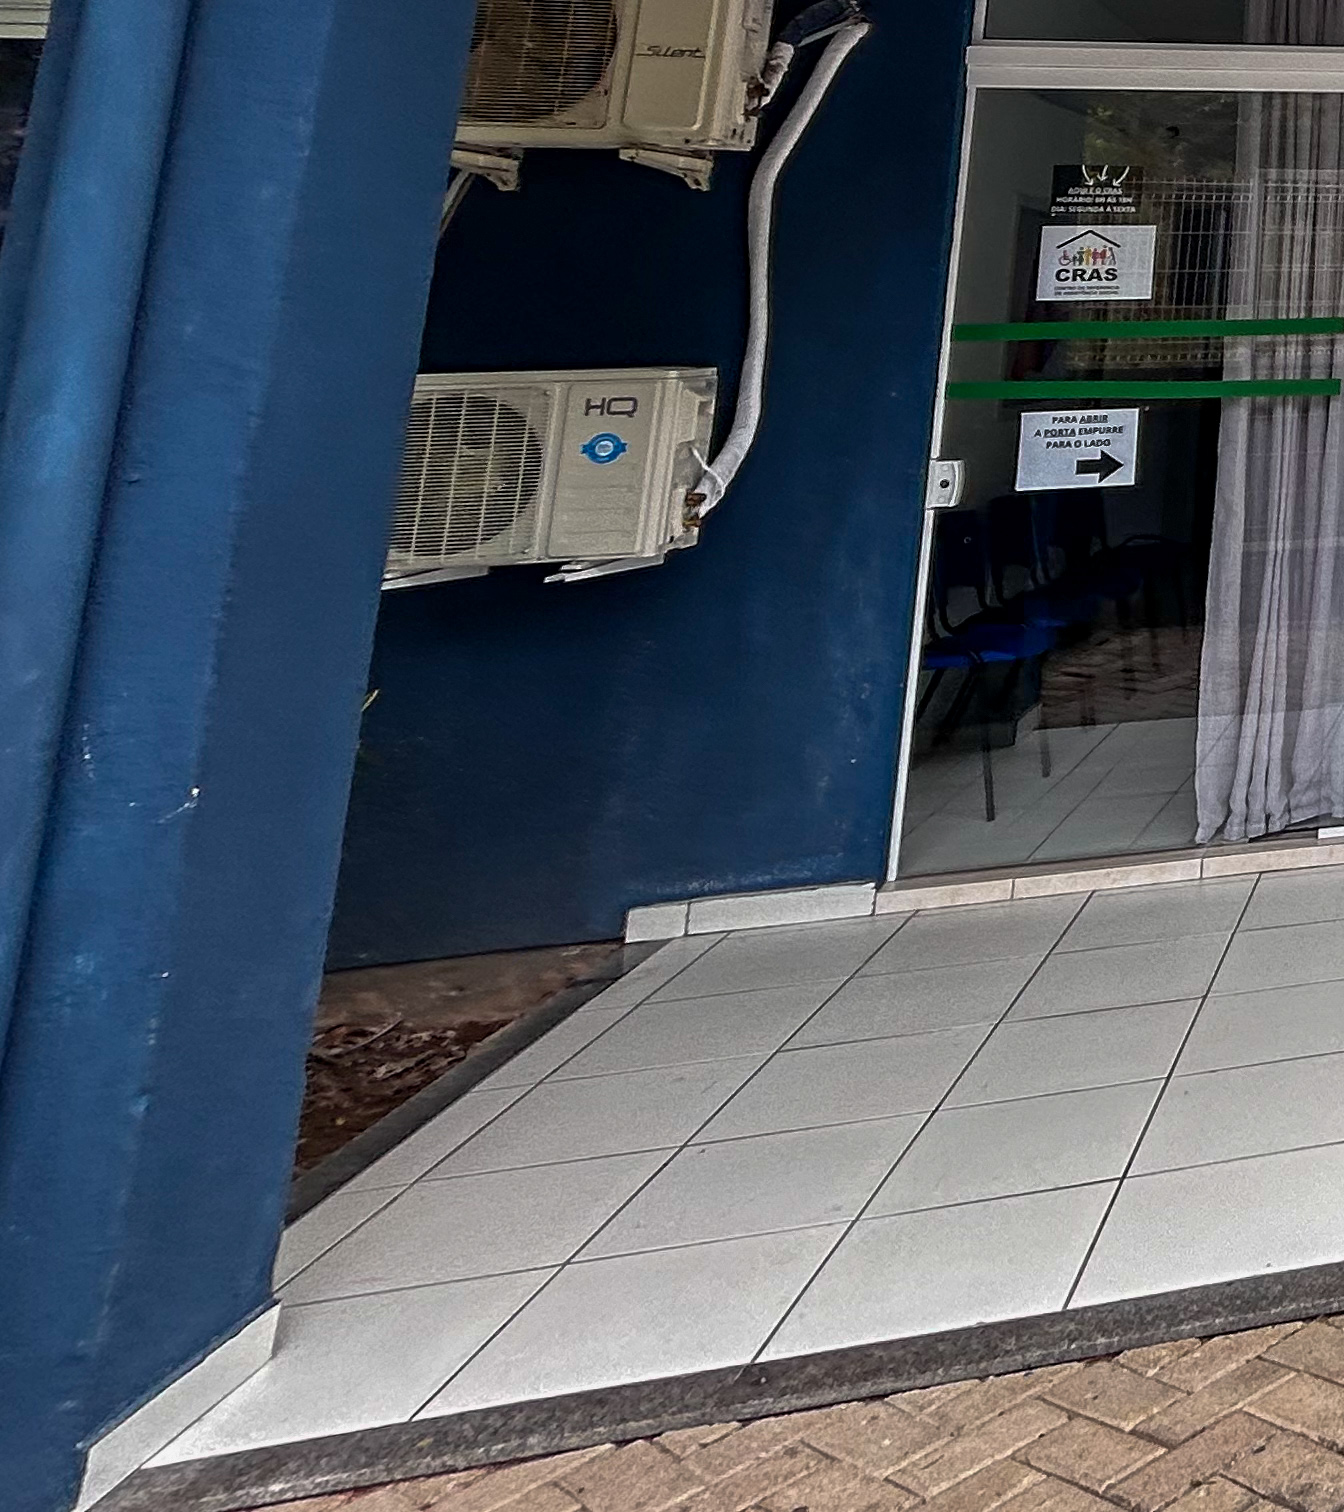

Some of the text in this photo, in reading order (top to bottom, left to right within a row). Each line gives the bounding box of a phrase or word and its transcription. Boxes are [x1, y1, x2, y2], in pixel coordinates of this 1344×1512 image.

[1054, 267, 1118, 282] CRAS
[584, 396, 638, 418] HQ
[1051, 414, 1109, 424] PARA ABRIR
[1033, 425, 1124, 438] A PORTA EMPURRE
[1046, 438, 1112, 449] PARA O LADO
